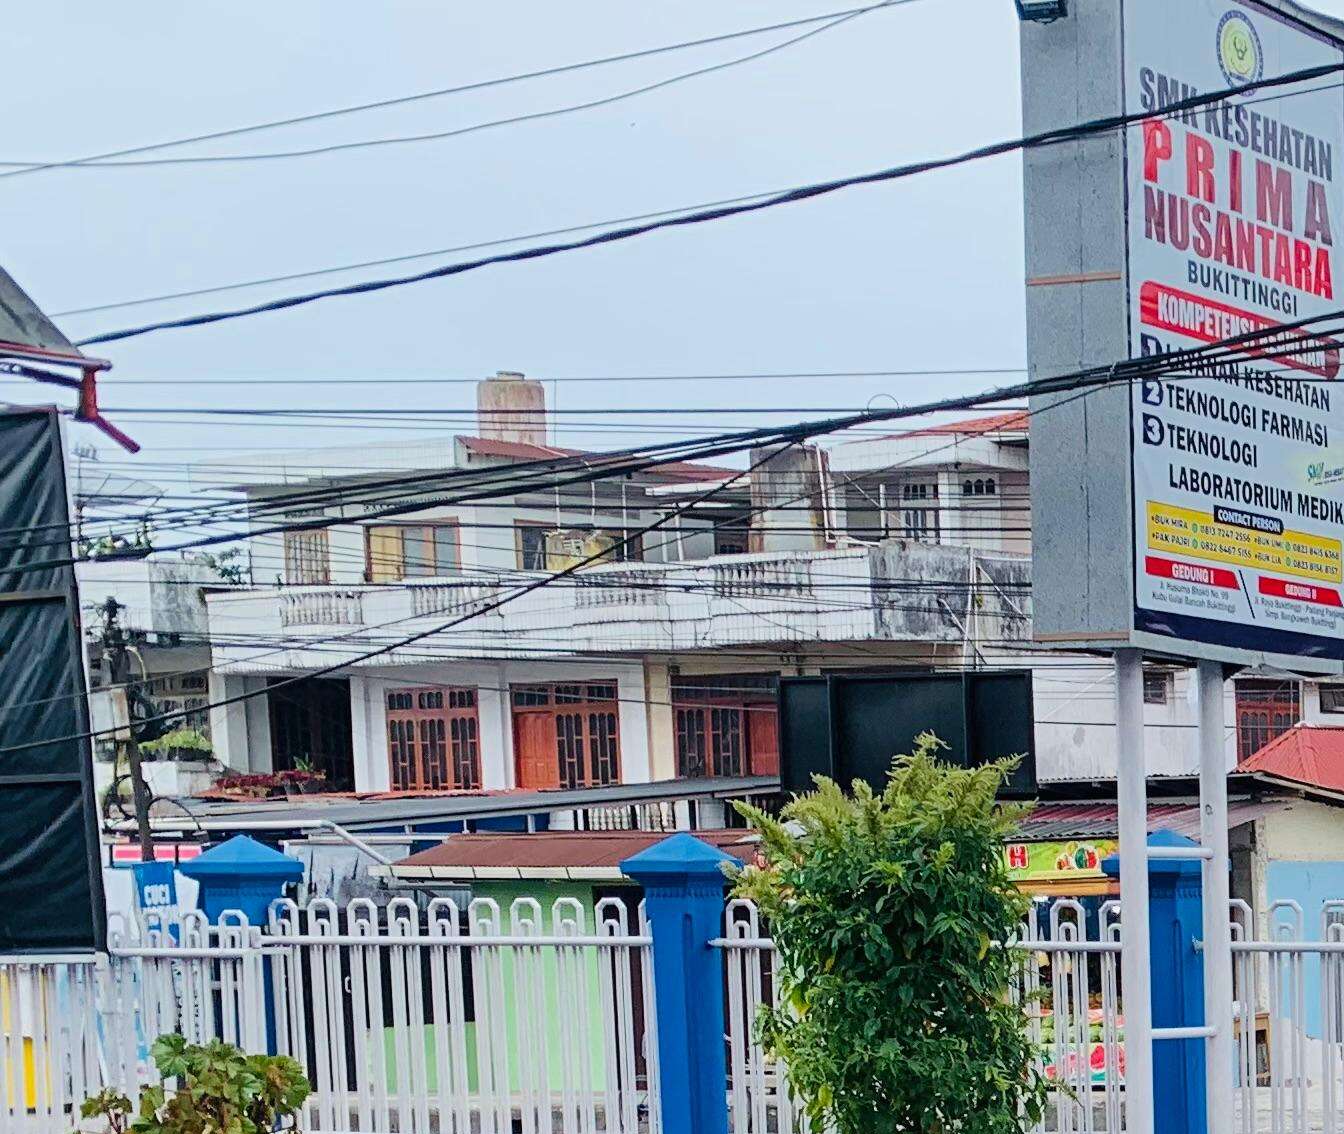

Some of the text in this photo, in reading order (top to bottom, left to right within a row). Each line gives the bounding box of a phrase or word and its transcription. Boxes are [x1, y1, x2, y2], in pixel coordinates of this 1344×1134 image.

[1140, 66, 1333, 182] SMK KESEHATAN
[1142, 116, 1333, 247] PRIMA
[1144, 184, 1333, 300] NUSANTARA
[1187, 259, 1298, 317] BUKITTINGGI
[1168, 383, 1257, 430] TEKNOLOGI
[1262, 410, 1328, 448] FARMASI
[1244, 365, 1330, 412] KESEHATAN
[1168, 423, 1257, 468] TEKNOLOGI
[1169, 463, 1344, 525] LABORATORIUM MEDIK
[1172, 563, 1209, 584] GEDUNG
